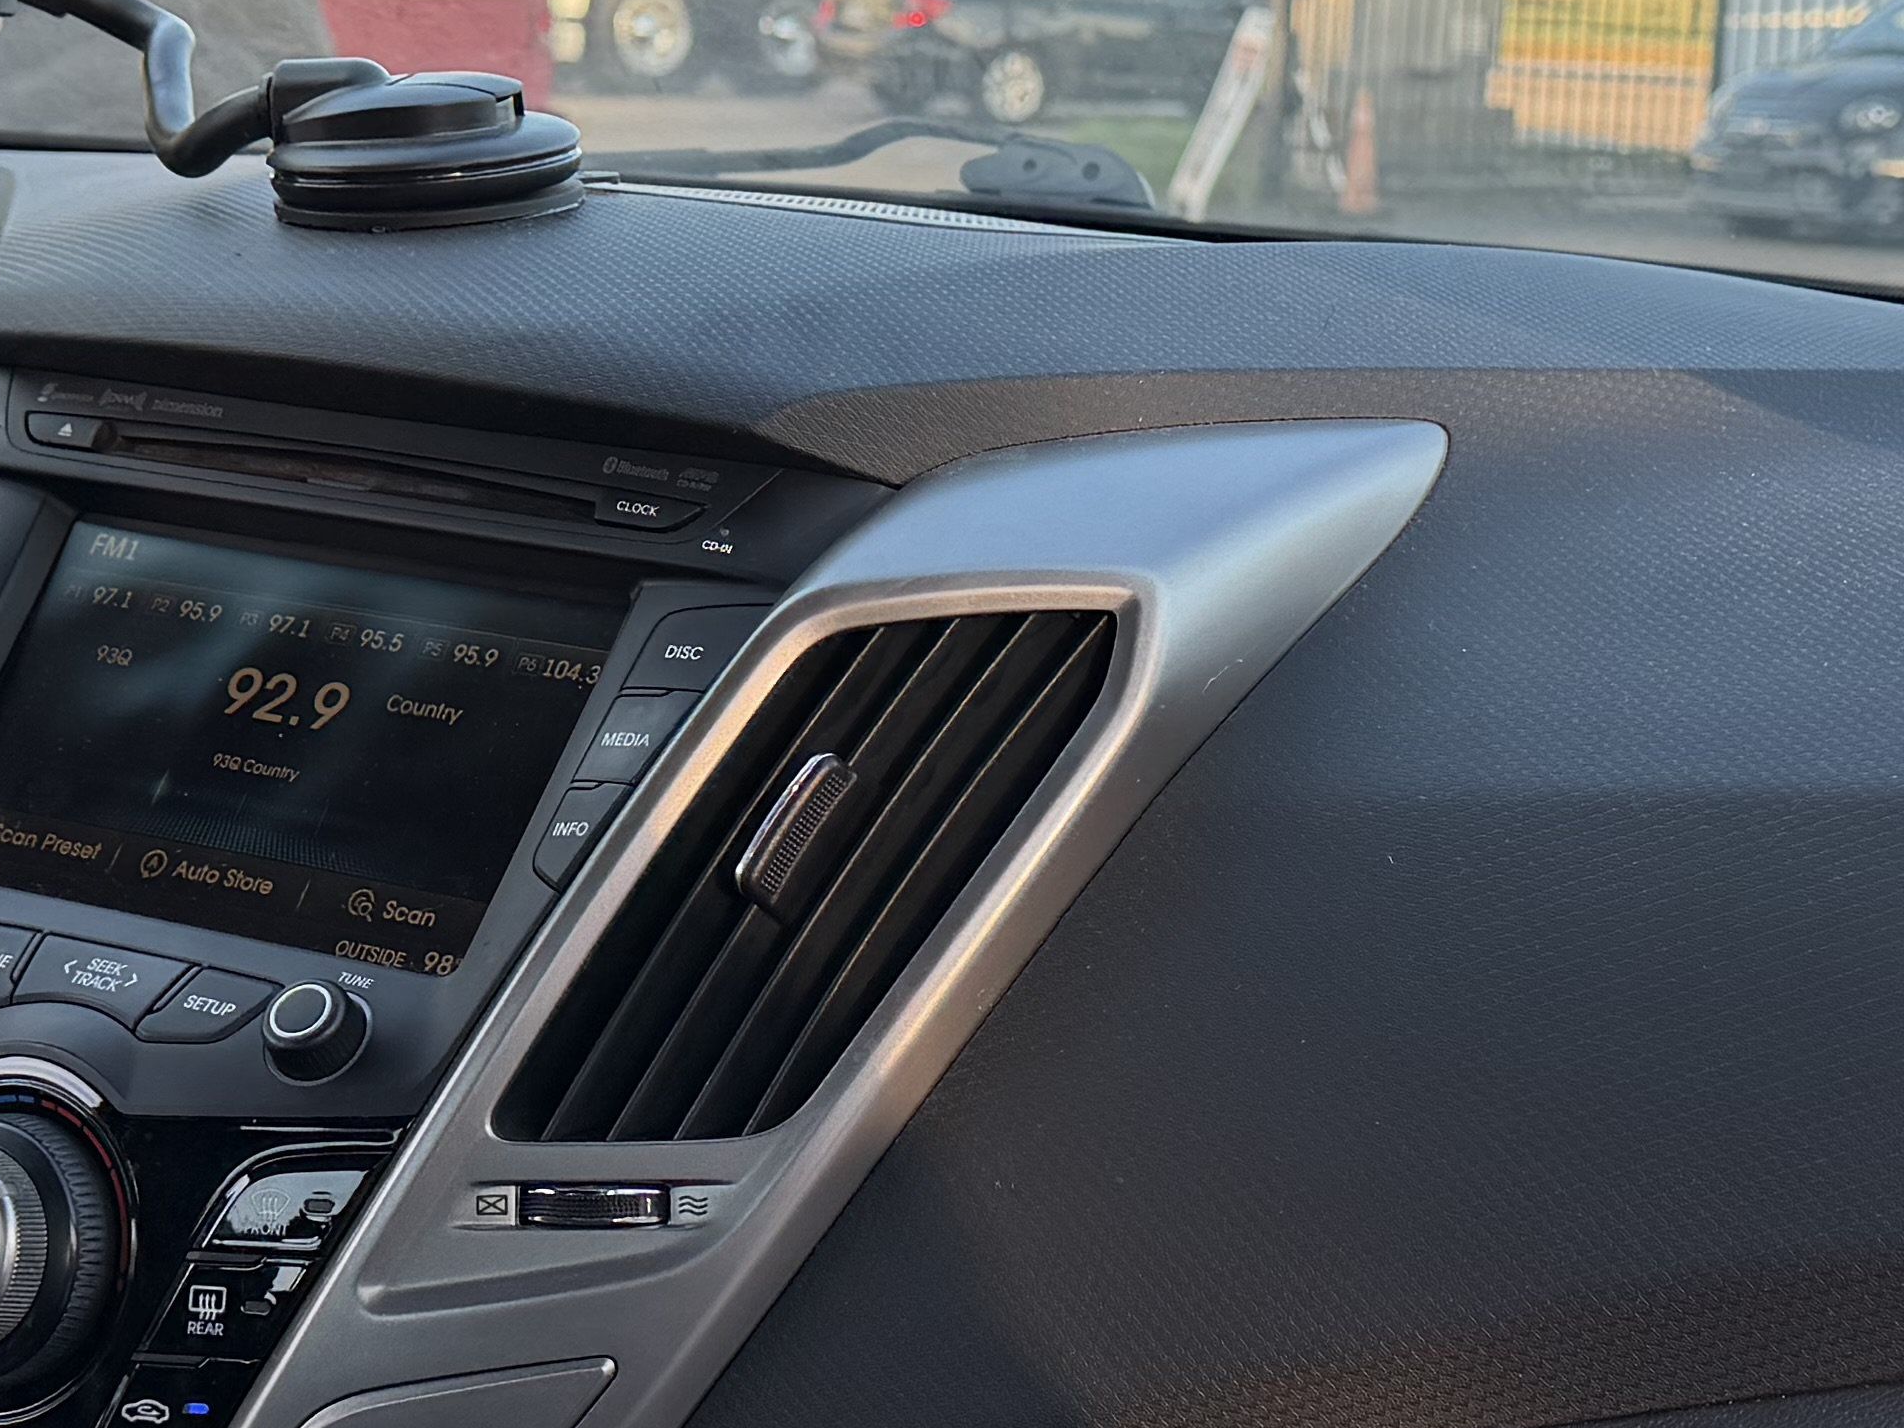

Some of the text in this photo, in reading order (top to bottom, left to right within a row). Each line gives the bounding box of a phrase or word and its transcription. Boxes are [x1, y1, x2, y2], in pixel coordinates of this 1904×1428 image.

[617, 460, 670, 482] Bluetooth
[616, 500, 661, 517] CLOCK
[90, 533, 140, 562] FM1
[92, 586, 132, 610] 97.1
[151, 597, 170, 613] P2
[179, 600, 223, 623] 95.9
[240, 612, 259, 626] P3
[269, 614, 311, 639] 97.1
[330, 625, 351, 642] P4
[360, 628, 405, 653] 95.5
[422, 640, 443, 657] P5
[453, 643, 500, 668] 95.9
[517, 656, 537, 672] P6
[542, 658, 602, 686] 104.3
[96, 644, 133, 667] 93Q
[664, 644, 705, 661] DISC
[224, 667, 351, 730] 92.9
[386, 694, 464, 725] Country
[600, 732, 650, 747] MEDIA
[213, 753, 301, 783] 93Q Country
[552, 822, 589, 837] INFO
[41, 834, 103, 859] Preset
[172, 860, 274, 896] Auto Store
[382, 900, 437, 928] Scan
[335, 940, 407, 968] OUTSIDE
[86, 957, 129, 976] SEEK
[71, 970, 125, 992] TRACK
[337, 972, 375, 989] TUNE
[183, 994, 237, 1016] SETUP
[244, 1223, 288, 1237] FRONT
[187, 1321, 224, 1336] REAR
